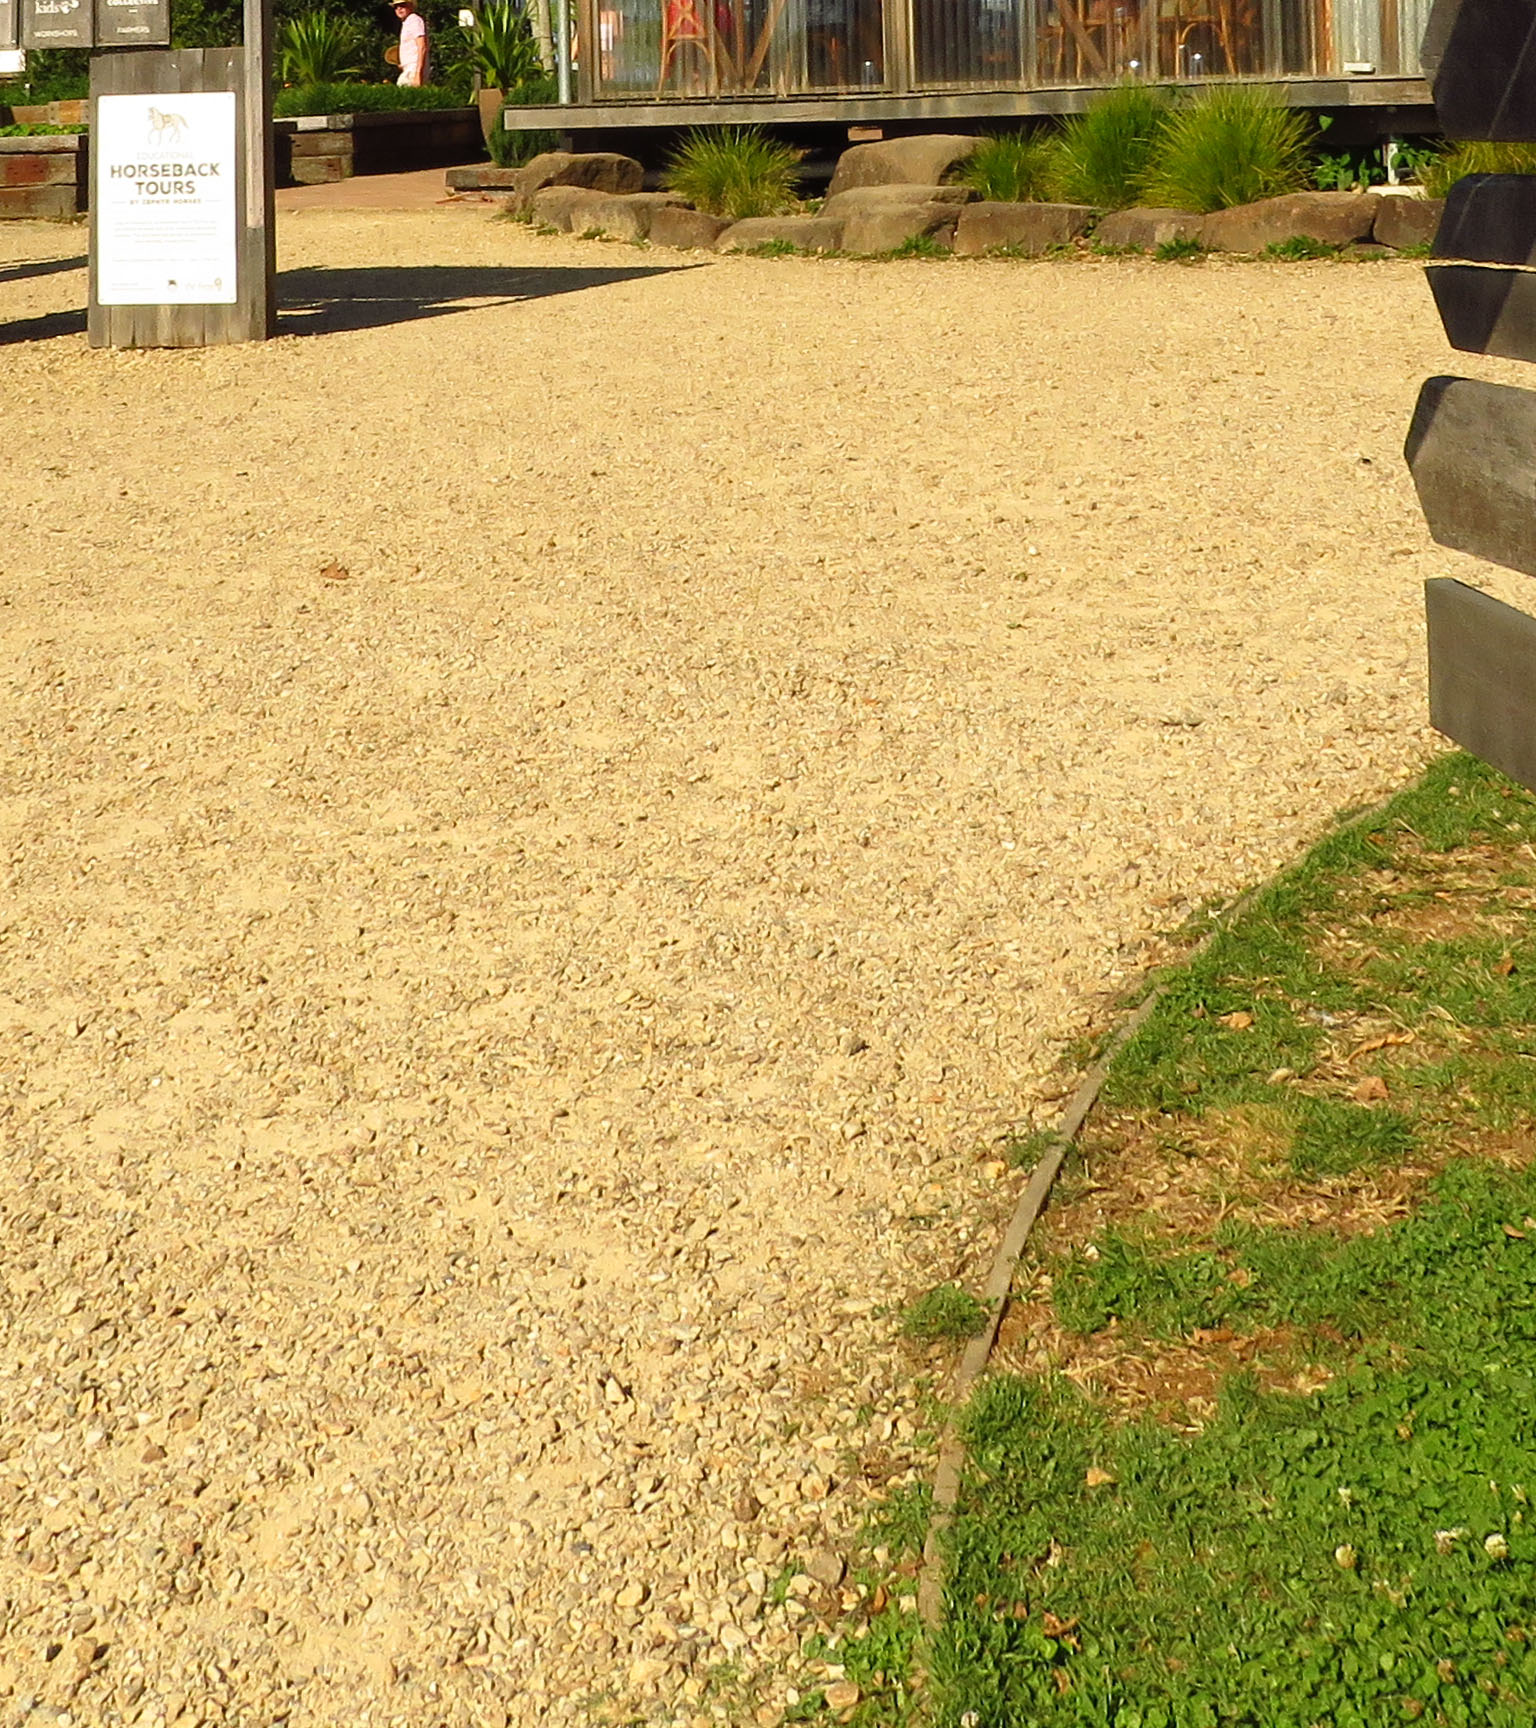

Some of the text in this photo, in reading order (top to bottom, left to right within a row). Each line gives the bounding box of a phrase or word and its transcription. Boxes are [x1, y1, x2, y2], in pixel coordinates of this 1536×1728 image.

[35, 0, 61, 14] kids
[110, 162, 221, 178] HORSEBACK
[135, 180, 196, 195] TOURS
